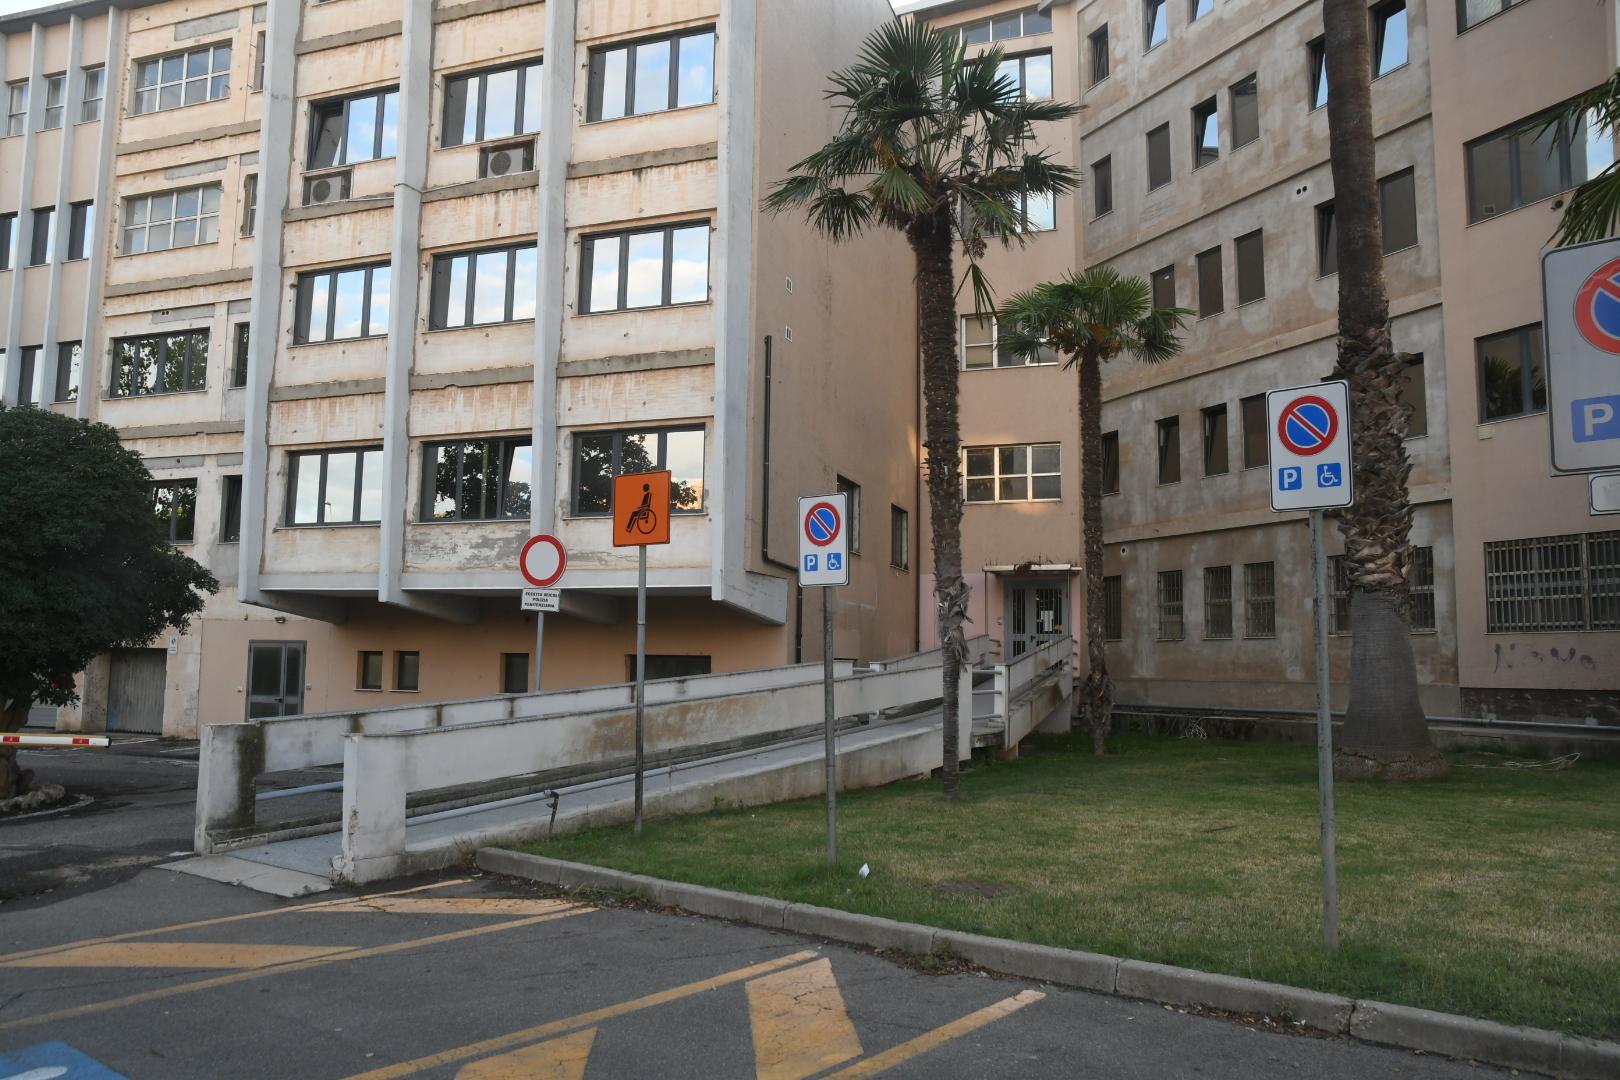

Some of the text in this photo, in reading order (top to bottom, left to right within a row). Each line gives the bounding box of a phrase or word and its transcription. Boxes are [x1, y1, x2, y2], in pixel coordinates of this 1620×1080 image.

[1583, 403, 1614, 436] P
[1283, 469, 1298, 489] P
[806, 555, 816, 570] P
